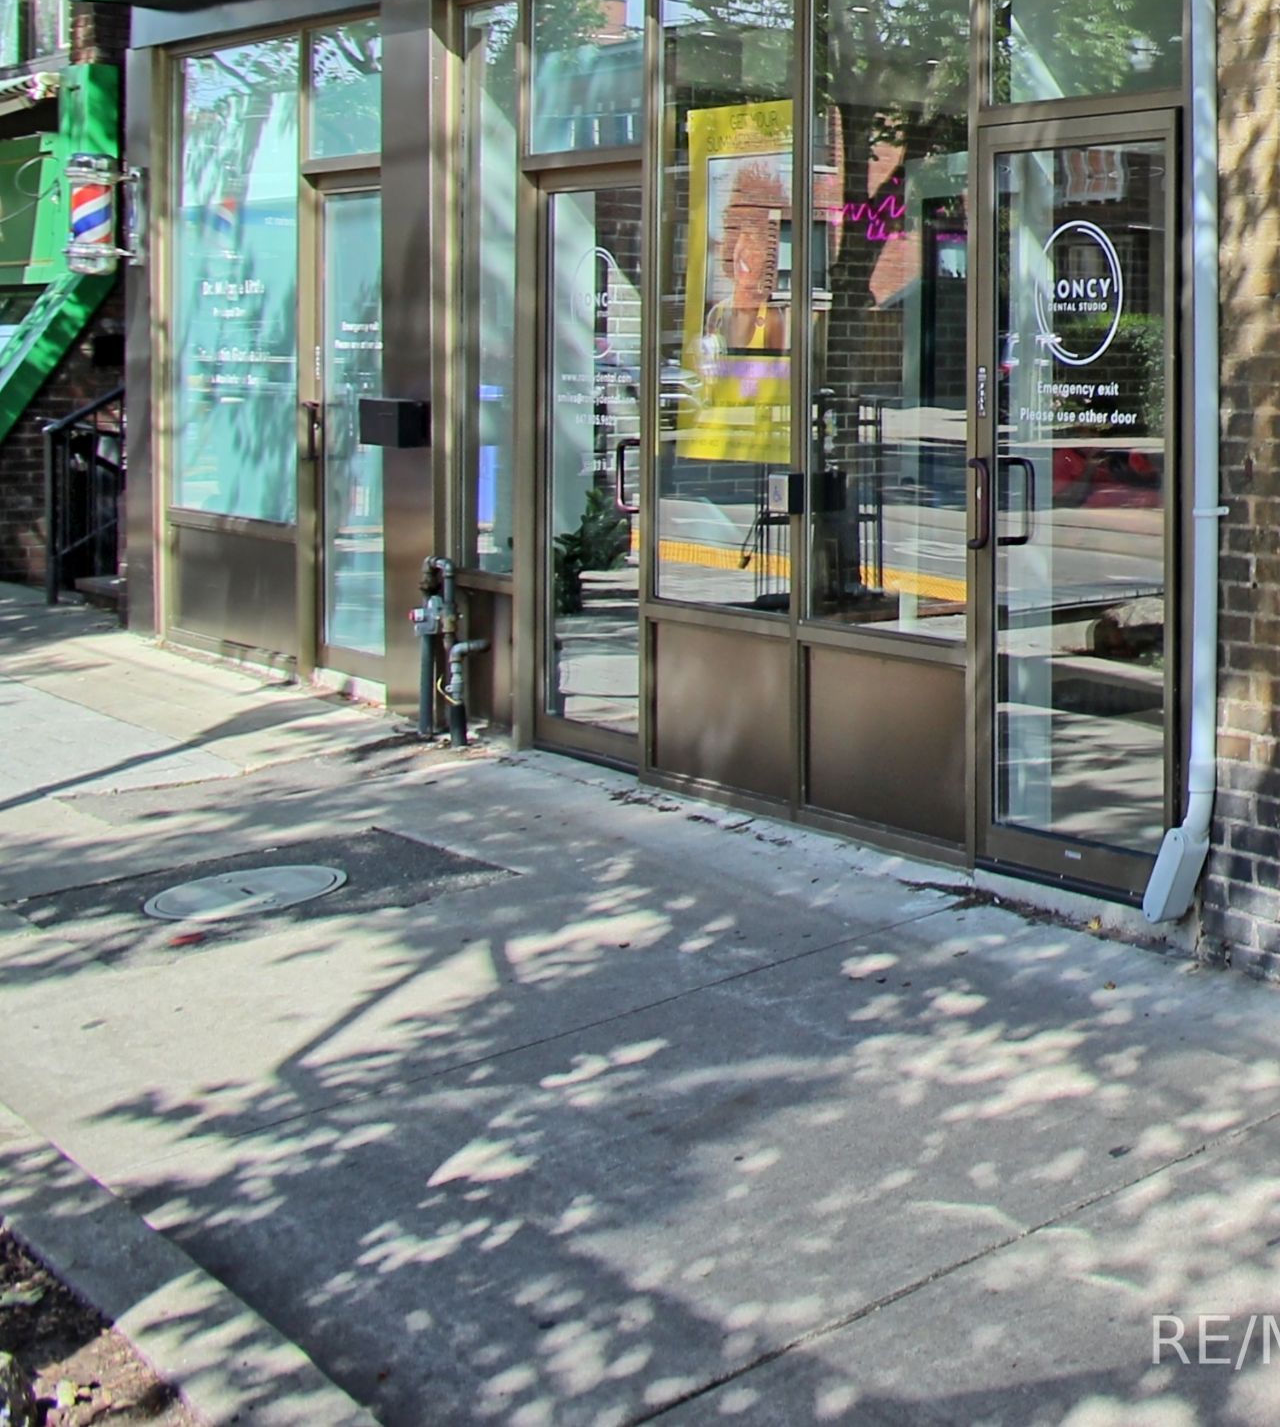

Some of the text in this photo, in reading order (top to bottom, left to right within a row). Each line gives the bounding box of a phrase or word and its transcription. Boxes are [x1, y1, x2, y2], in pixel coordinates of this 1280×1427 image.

[1048, 301, 1108, 312] DENTAL STUDIO
[1037, 381, 1120, 398] Emergency exit
[1020, 407, 1138, 425] Please use other door
